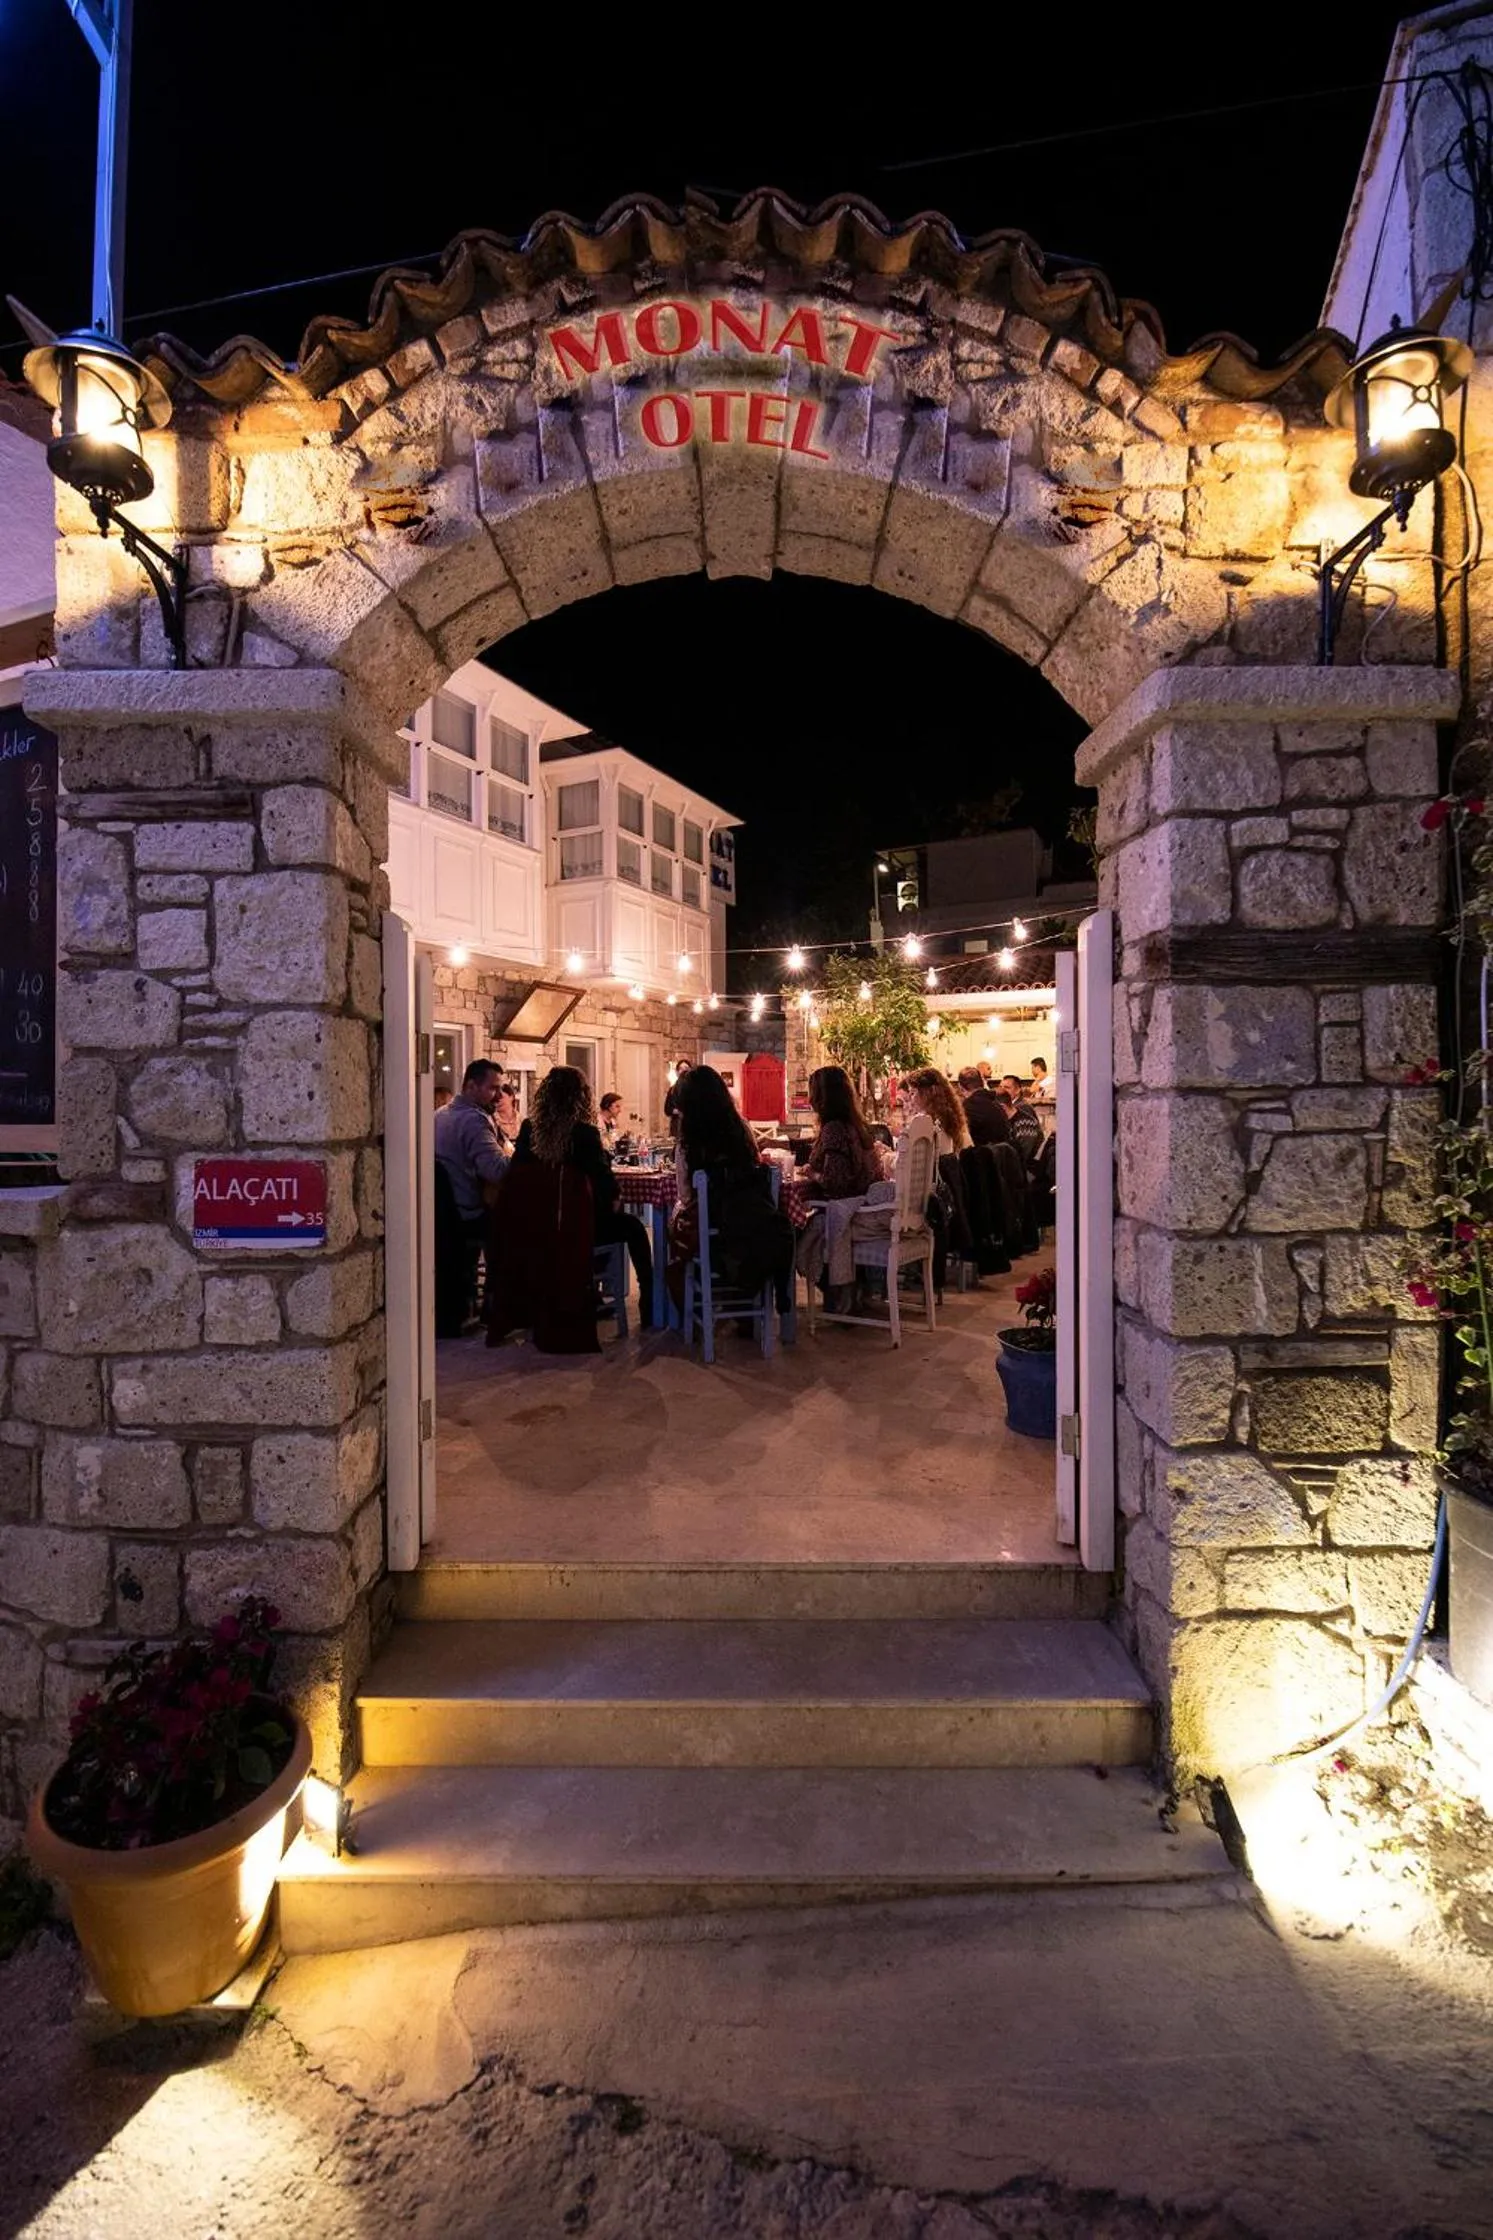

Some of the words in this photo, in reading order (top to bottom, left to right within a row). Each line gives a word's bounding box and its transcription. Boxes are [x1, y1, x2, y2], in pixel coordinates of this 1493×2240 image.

[548, 299, 900, 381] MONAT
[641, 390, 830, 460] OTEL
[27, 763, 47, 792] 2
[26, 799, 43, 825] 5
[29, 831, 41, 857] 8
[28, 889, 39, 922] 8
[17, 971, 44, 996] 40
[193, 1178, 298, 1206] ALAÇATI
[306, 1212, 324, 1226] 35
